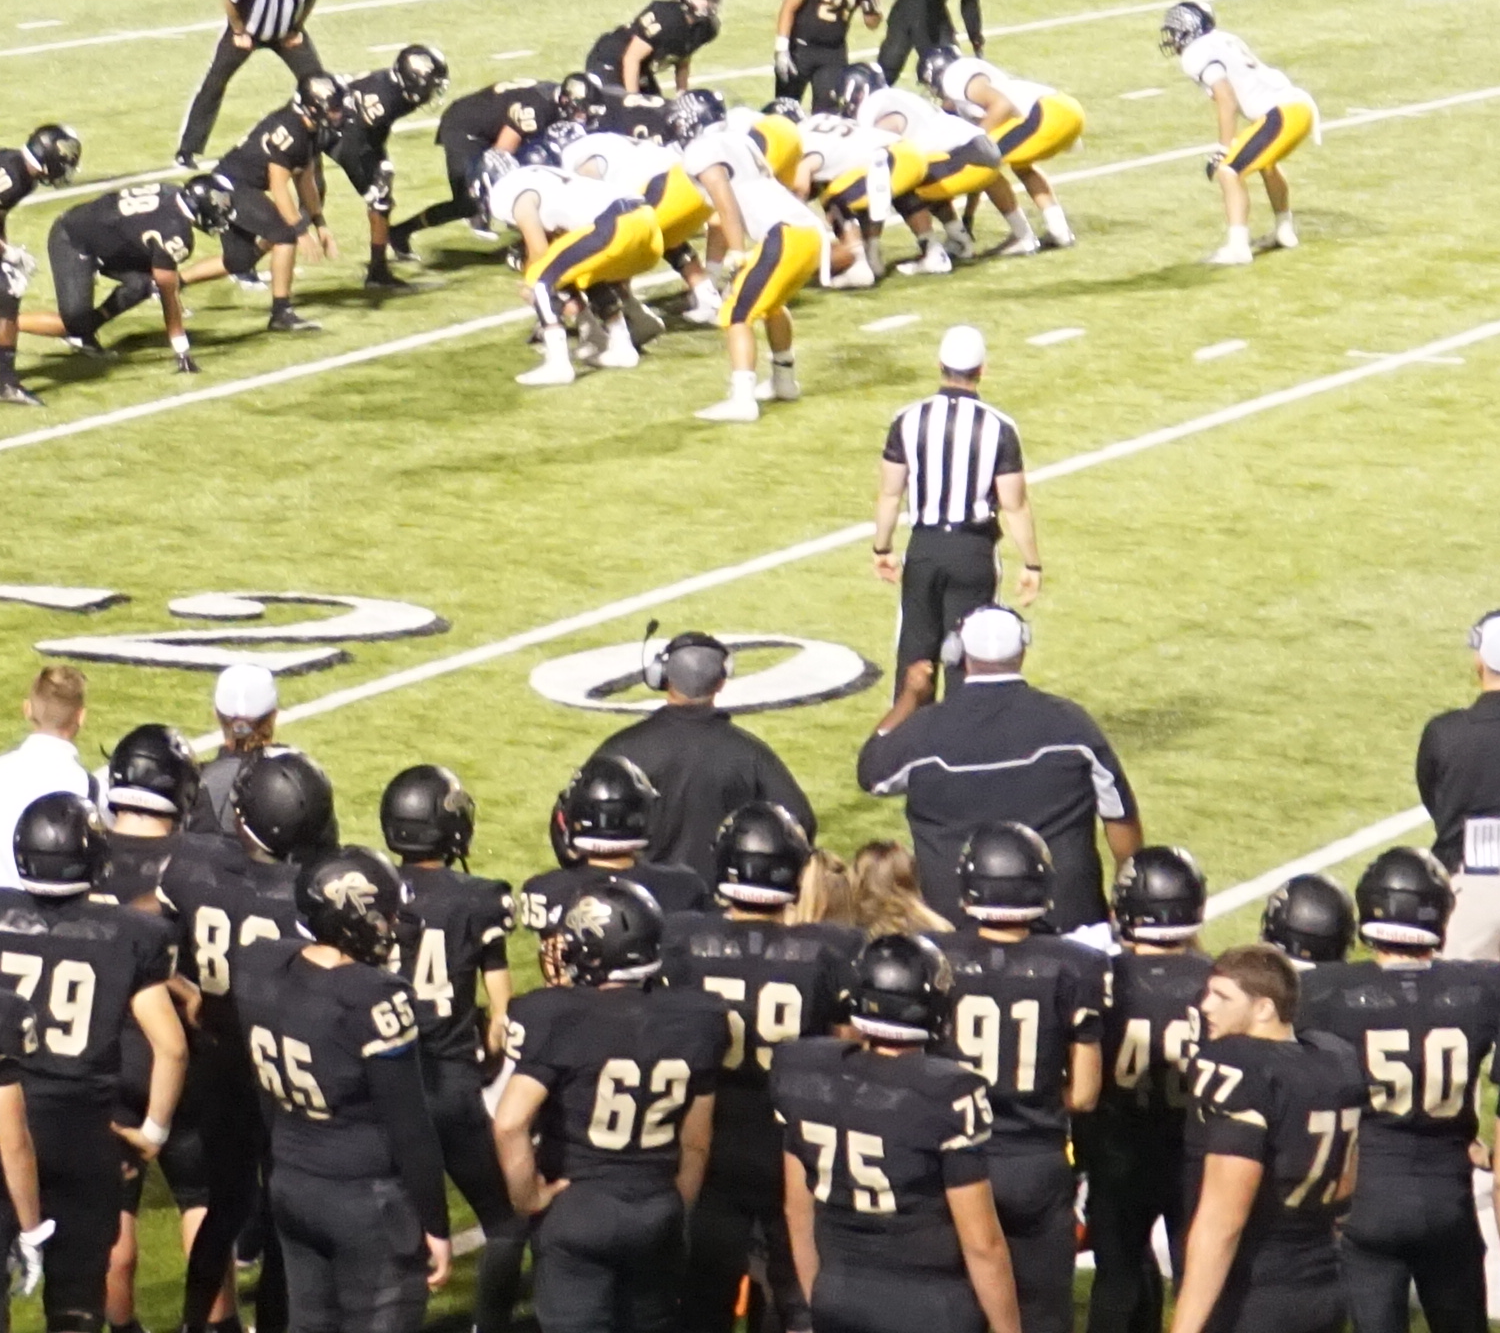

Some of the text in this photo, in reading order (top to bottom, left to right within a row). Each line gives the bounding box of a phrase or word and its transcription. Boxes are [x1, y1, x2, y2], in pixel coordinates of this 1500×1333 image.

[0, 951, 96, 1056] 79
[371, 991, 415, 1039] 65
[956, 994, 1039, 1091] 91
[251, 1025, 333, 1121] 65
[587, 1058, 692, 1150] 62
[951, 1085, 995, 1135] 75
[1193, 1059, 1243, 1103] 77
[1366, 1027, 1468, 1118] 50
[801, 1120, 897, 1214] 75
[1284, 1107, 1361, 1208] 77
